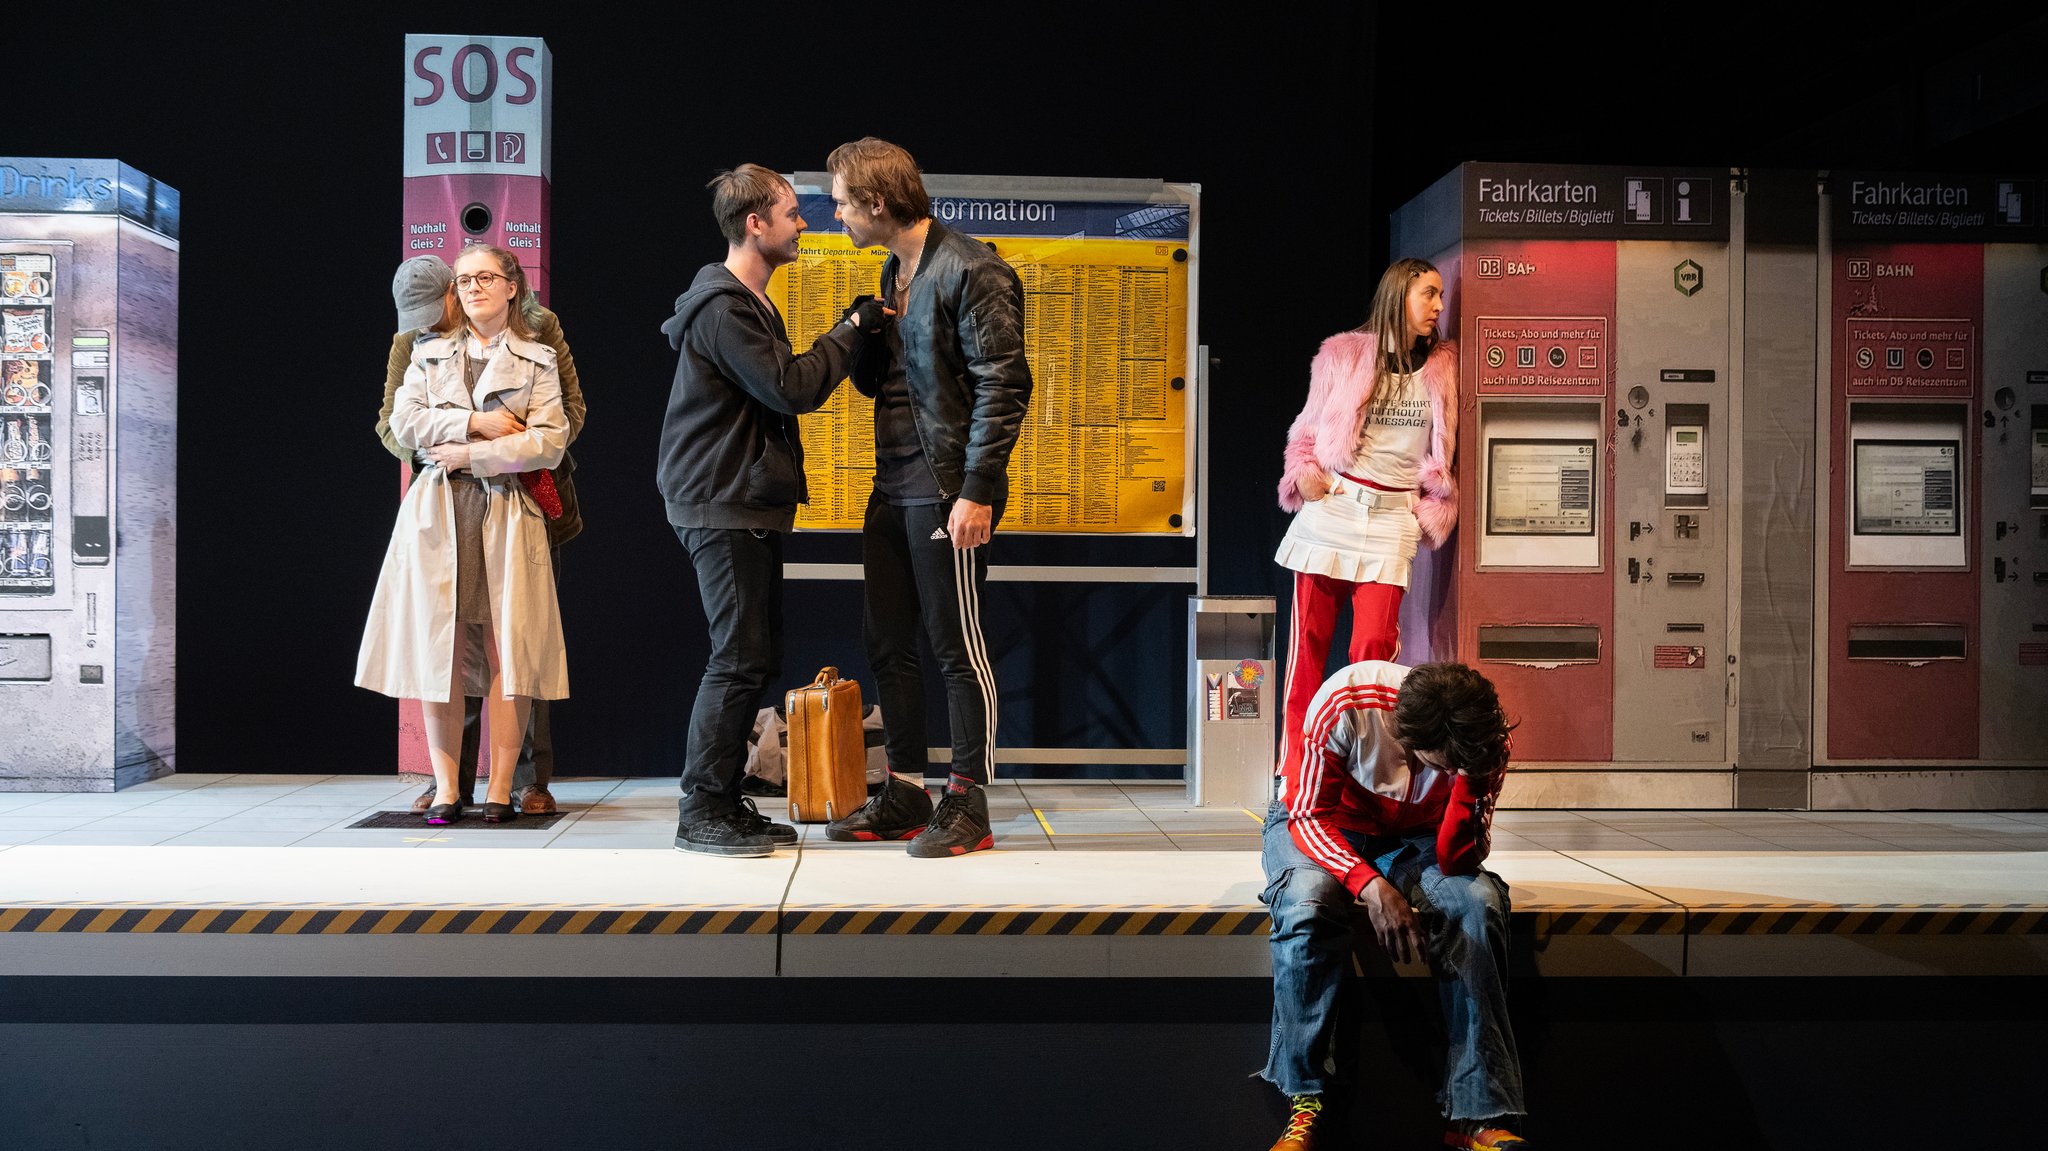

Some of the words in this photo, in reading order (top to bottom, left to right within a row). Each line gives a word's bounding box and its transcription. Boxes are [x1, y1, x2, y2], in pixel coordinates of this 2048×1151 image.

[413, 43, 537, 107] SOS
[0, 164, 112, 203] Drinks
[1479, 178, 1597, 203] Fahrkarten
[1852, 181, 1968, 206] Fahrkarten
[931, 197, 1056, 221] formation
[410, 222, 447, 235] Nothalt
[505, 221, 541, 234] Nothalt
[410, 238, 434, 250] Gleis
[437, 237, 444, 248] 2
[508, 237, 533, 248] Gleis
[535, 237, 541, 248] 1
[798, 247, 821, 255] fahrt
[822, 248, 861, 257] Departure
[1479, 259, 1500, 276] DB
[1507, 262, 1536, 275] BAH
[1849, 261, 1870, 278] DB
[1876, 263, 1914, 278] BAHN
[1680, 273, 1697, 282] VRR
[1483, 328, 1519, 339] Tickets,
[1521, 328, 1539, 338] Abo
[1541, 328, 1559, 338] und
[1561, 328, 1584, 339] mehr
[1587, 328, 1600, 339] für
[1853, 330, 1888, 341] Tickets,
[1890, 330, 1908, 340] Abo
[1910, 330, 1927, 340] und
[1929, 331, 1952, 341] mehr
[1489, 348, 1501, 364] S
[1521, 349, 1532, 364] U
[1859, 350, 1871, 365] S
[1890, 350, 1901, 366] U
[1483, 376, 1505, 385] auch
[1507, 376, 1519, 385] im
[1521, 376, 1535, 385] DB
[1538, 376, 1600, 386] Reisezentrum
[1853, 377, 1874, 386] auch
[1876, 377, 1888, 386] im
[1890, 376, 1904, 386] DB
[1906, 377, 1967, 387] Reisezentrum
[1401, 400, 1431, 408] SHIRT
[1371, 407, 1424, 417] WITHOUT
[1364, 416, 1371, 425] A
[1375, 417, 1427, 427] MESSAGE
